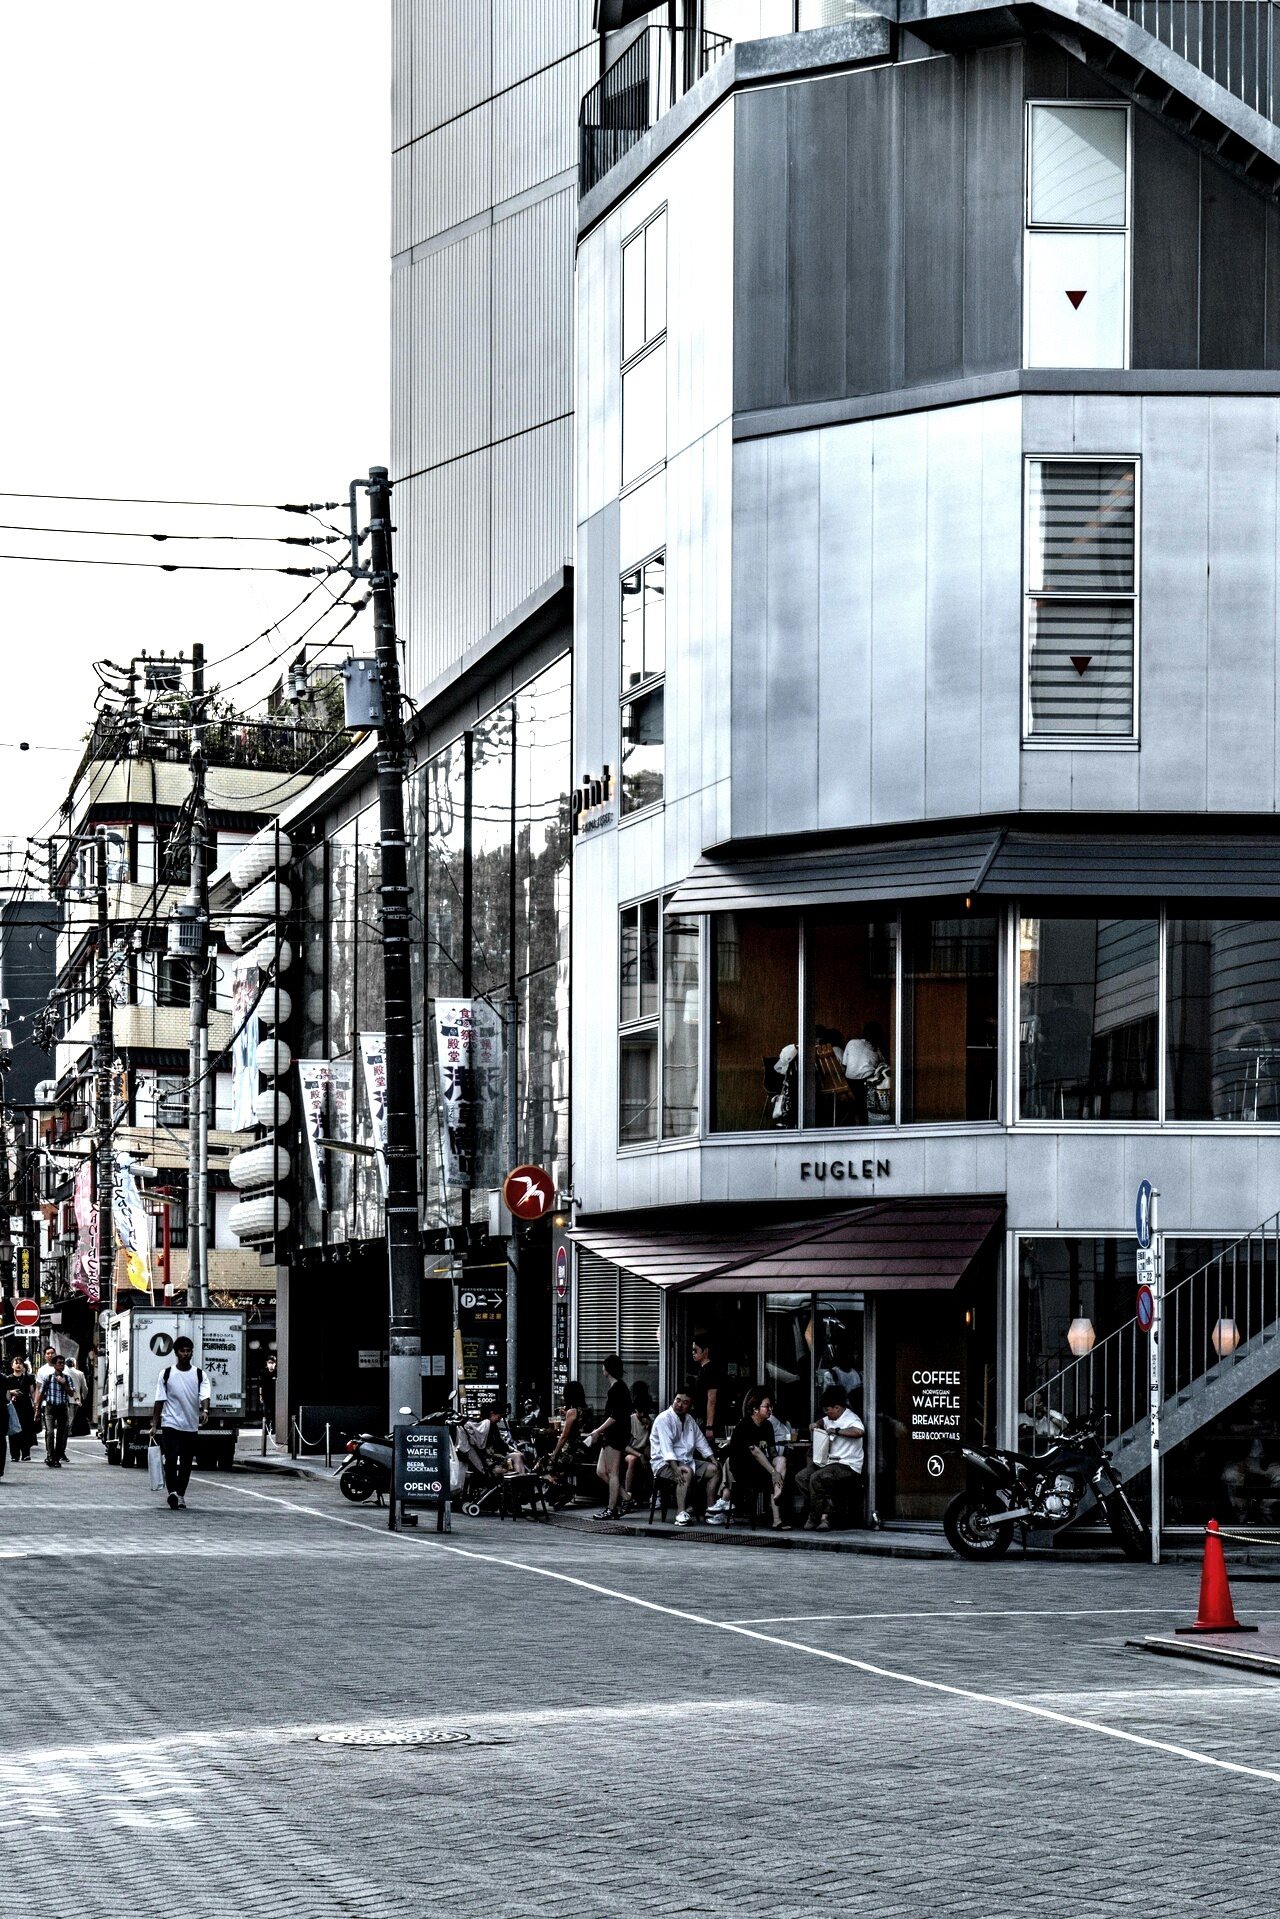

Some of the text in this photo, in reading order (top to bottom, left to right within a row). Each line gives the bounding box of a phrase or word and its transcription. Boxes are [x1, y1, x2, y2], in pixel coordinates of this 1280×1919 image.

[572, 765, 610, 835] pint
[447, 1038, 460, 1063] 殿堂
[800, 1159, 891, 1181] FUGLEN
[464, 1342, 478, 1358] 空
[464, 1364, 478, 1380] 空
[912, 1370, 960, 1384] COFFEE
[912, 1396, 960, 1408] WAFFLE
[912, 1414, 960, 1426] BREAKFAST
